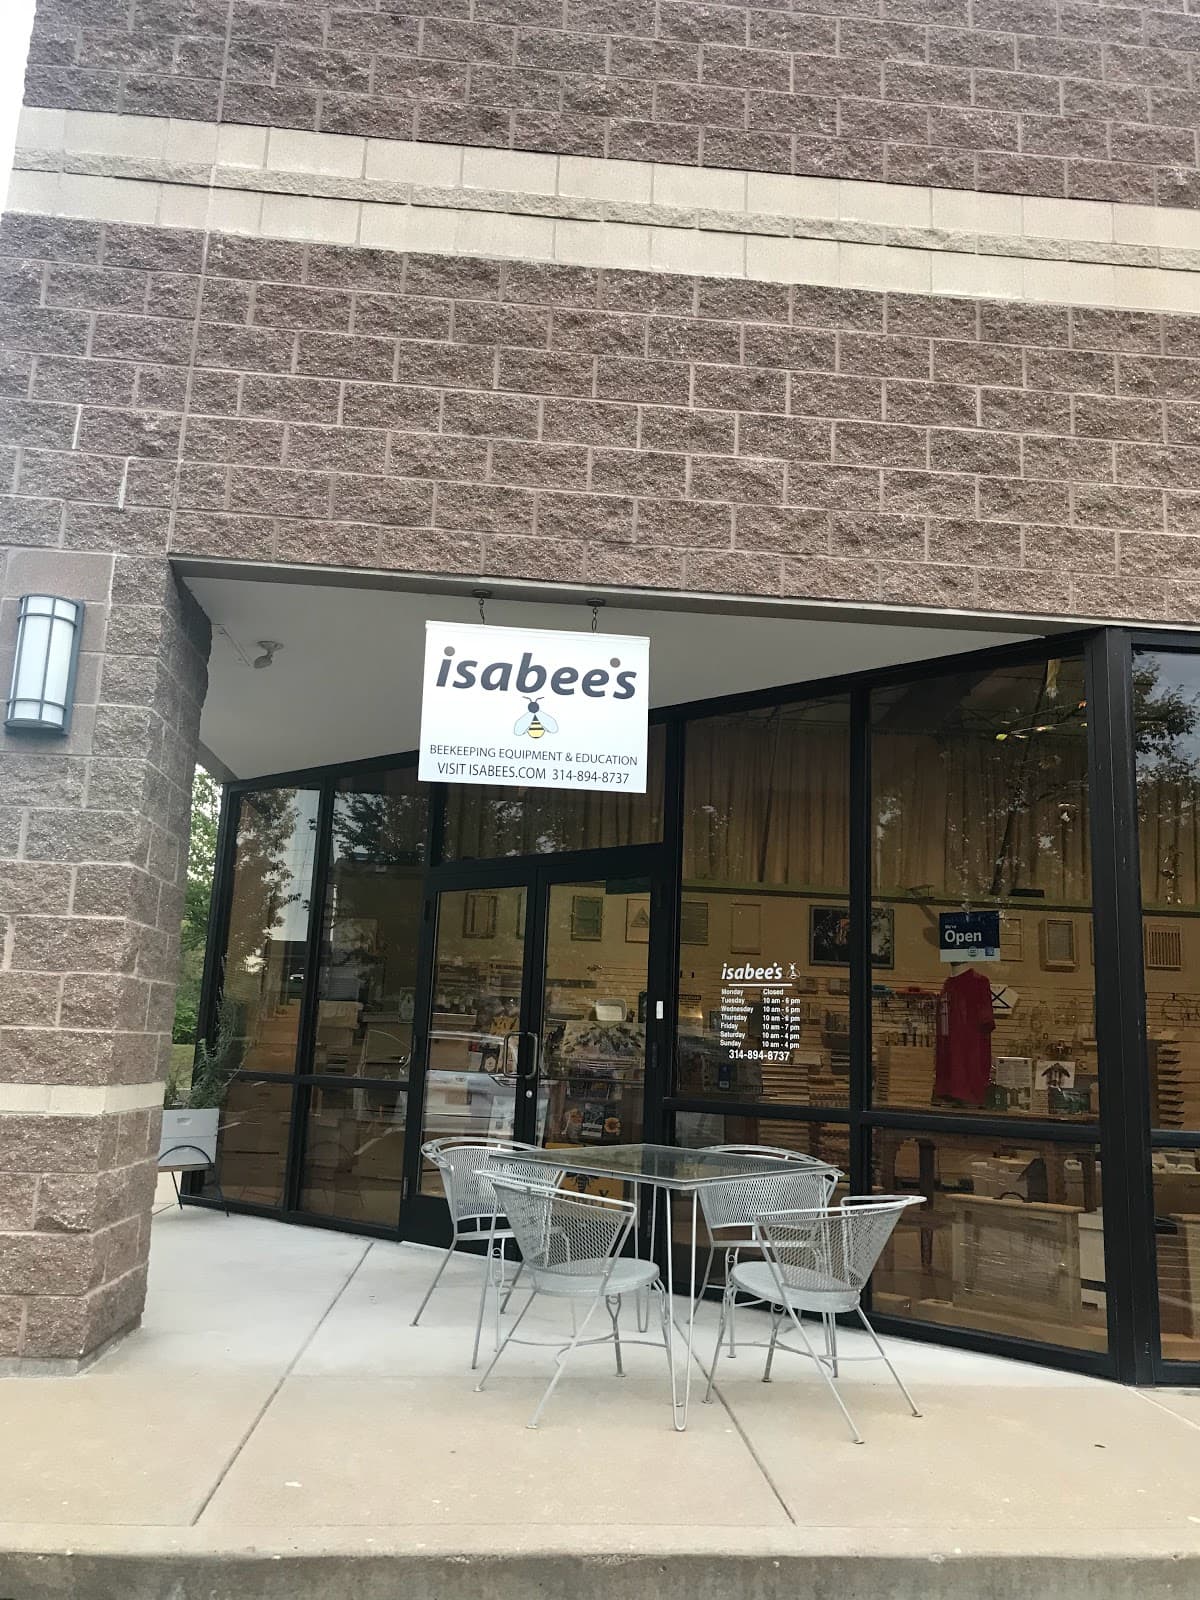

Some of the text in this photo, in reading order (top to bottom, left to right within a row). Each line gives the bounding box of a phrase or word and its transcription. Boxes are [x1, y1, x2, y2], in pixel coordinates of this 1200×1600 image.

[430, 745, 638, 766] BEEKEEPING EQUIPMENT & EDUCATION
[438, 762, 629, 784] VISIT ISABEES.COM 314-894-8737
[945, 930, 982, 945] Open
[729, 1049, 790, 1060] 314-894-8737
